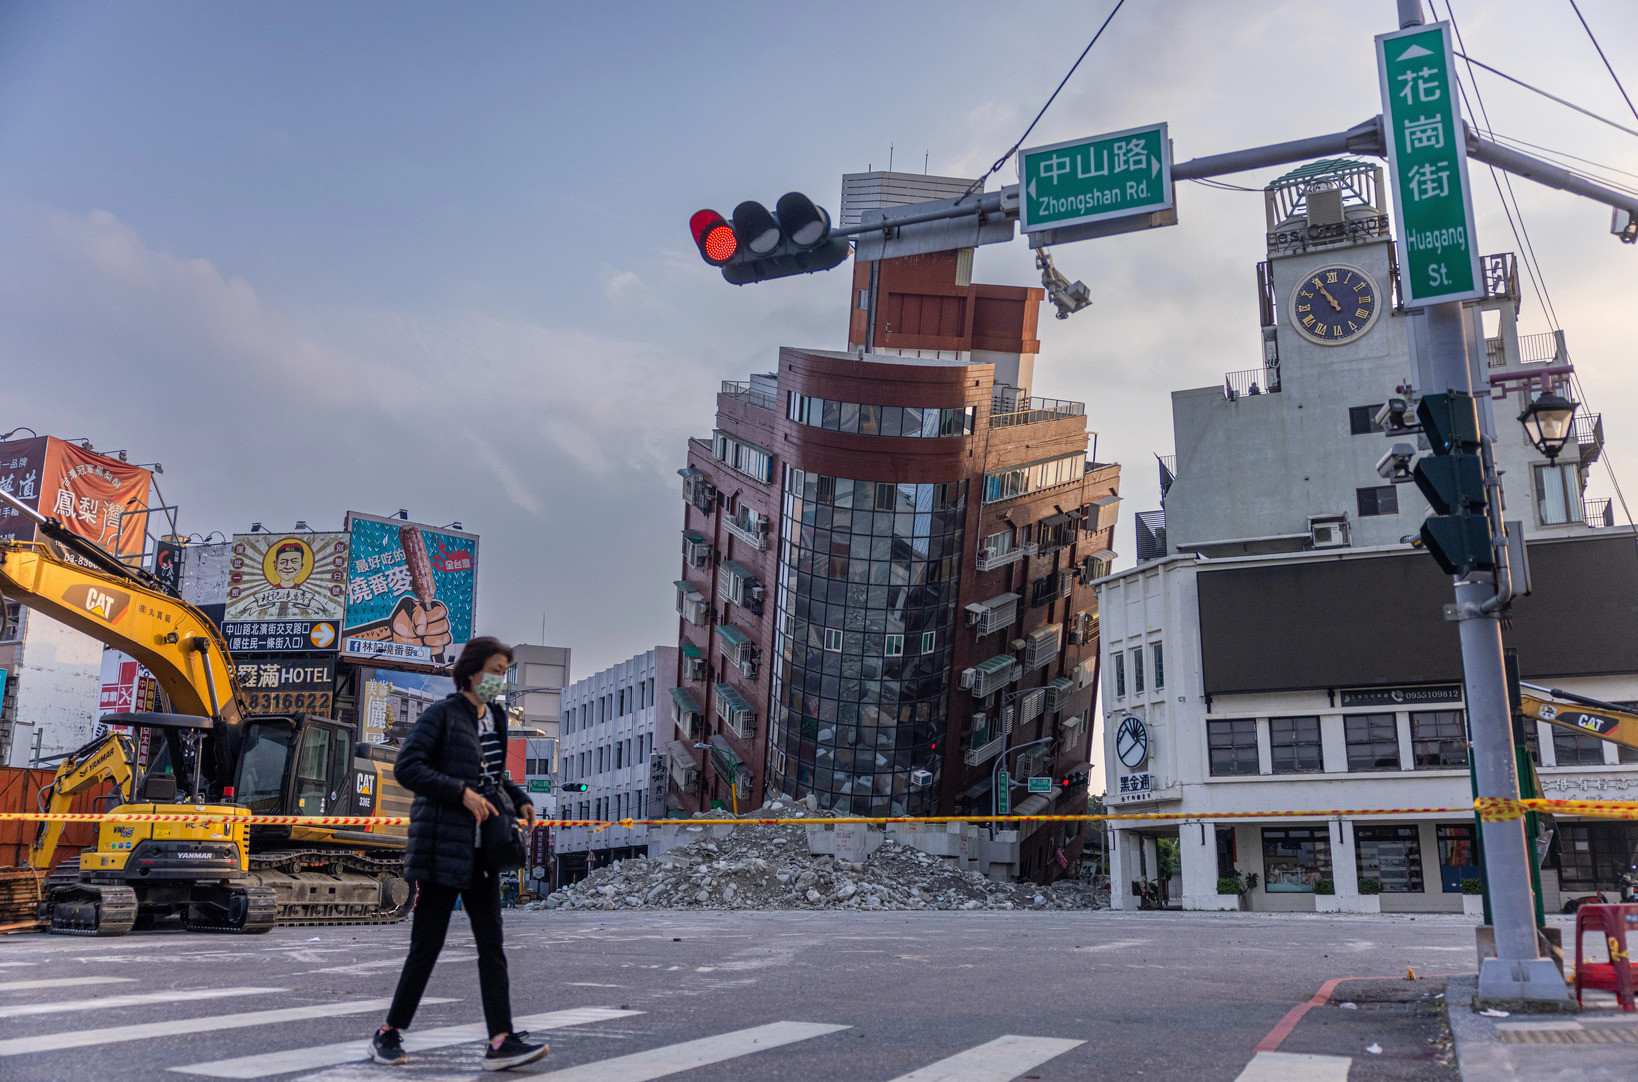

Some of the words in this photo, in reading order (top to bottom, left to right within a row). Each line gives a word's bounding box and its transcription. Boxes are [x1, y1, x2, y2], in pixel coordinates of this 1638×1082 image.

[1397, 66, 1450, 201] 花崗街
[1039, 138, 1148, 185] 中山路
[1038, 187, 1121, 215] Zhongshan
[1126, 179, 1151, 200] Rd.
[1407, 225, 1465, 254] Huagang
[1428, 262, 1452, 287] St.
[0, 457, 27, 469] 一品牌
[61, 464, 122, 489] 台灣冠軍鳳梨酥
[355, 549, 406, 573] 最好吃的
[445, 559, 471, 570] 全台灣
[347, 565, 413, 605] 燒番麥
[85, 588, 114, 619] CAT
[226, 623, 310, 636] 中山路北濱街交叉路口
[229, 636, 304, 650] (原住民一條街入口)
[228, 664, 280, 688] 羅滿
[281, 667, 331, 683] HOTEL
[248, 693, 330, 709] 8316622
[1405, 690, 1459, 699] 0955109812
[1578, 714, 1604, 731] CAT
[88, 747, 115, 771] YANMAR
[357, 773, 375, 795] CAT
[1120, 774, 1150, 793] 黑金通
